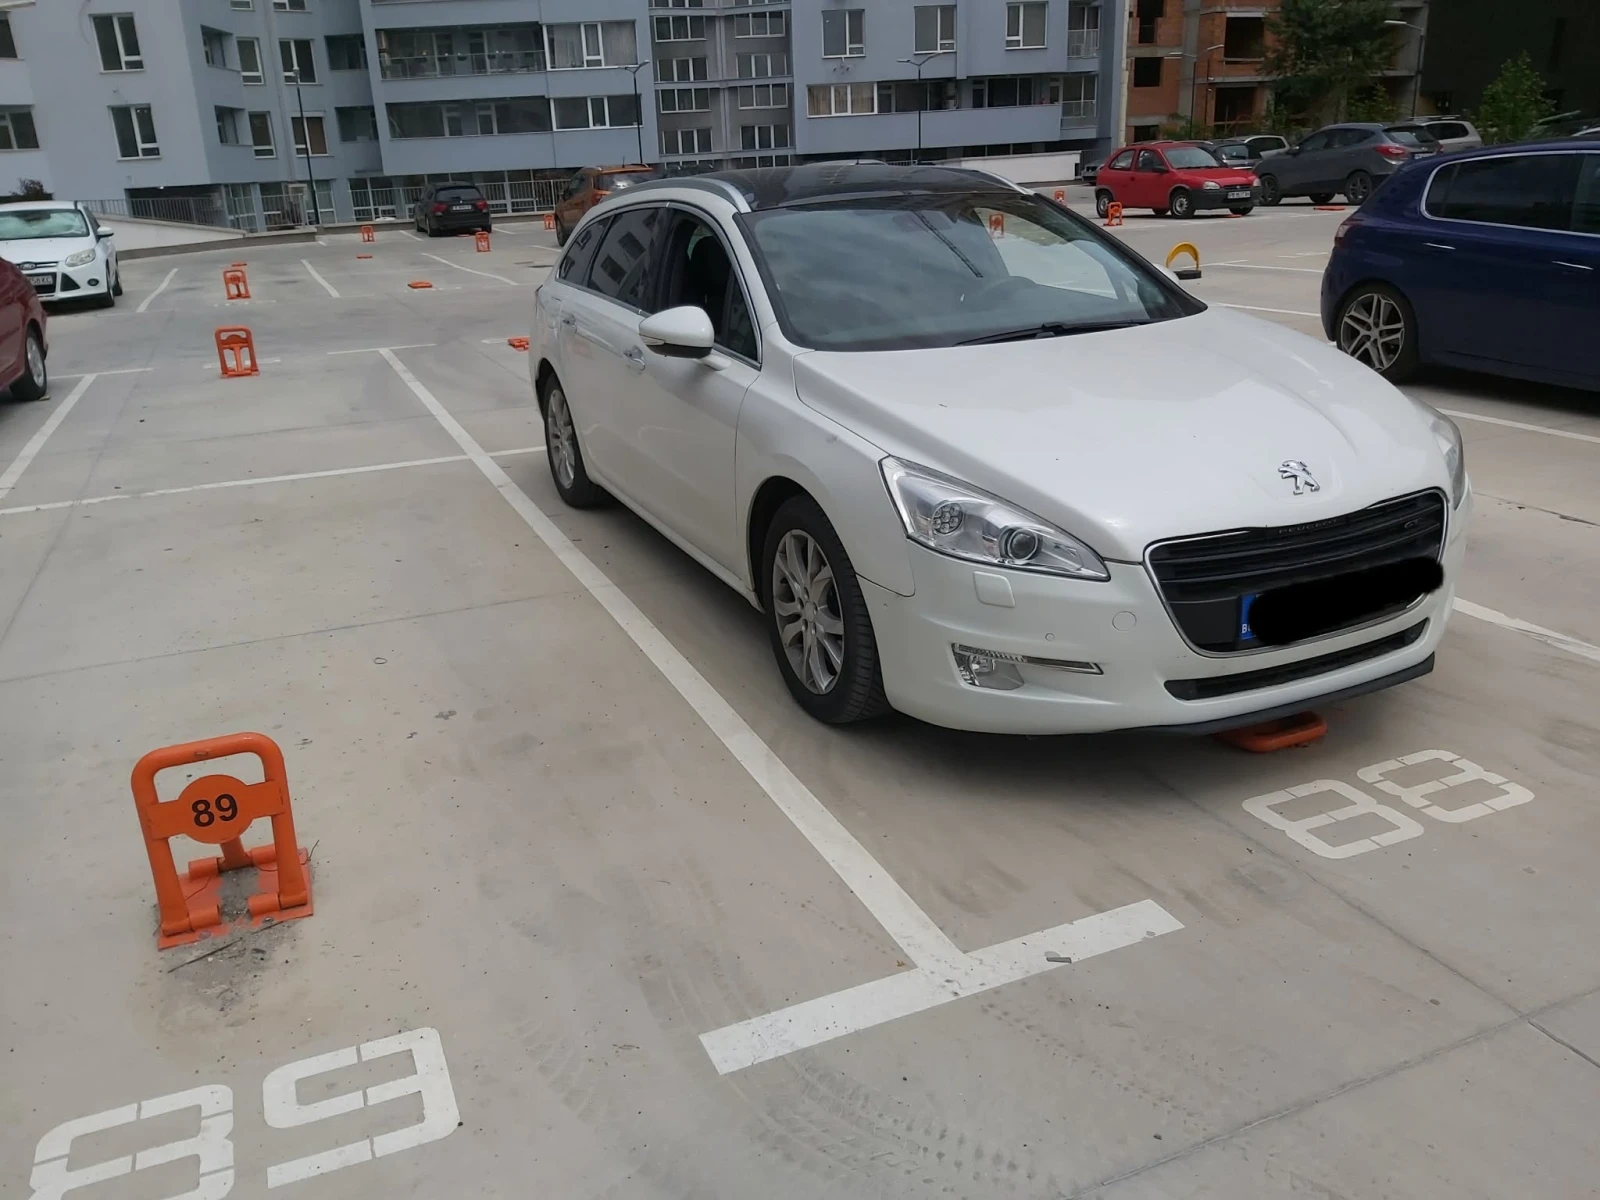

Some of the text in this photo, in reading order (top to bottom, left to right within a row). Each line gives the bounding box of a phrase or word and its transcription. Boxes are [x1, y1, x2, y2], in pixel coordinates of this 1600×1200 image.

[191, 793, 238, 828] 89
[1242, 749, 1535, 859] 88
[28, 1026, 461, 1200] 89
